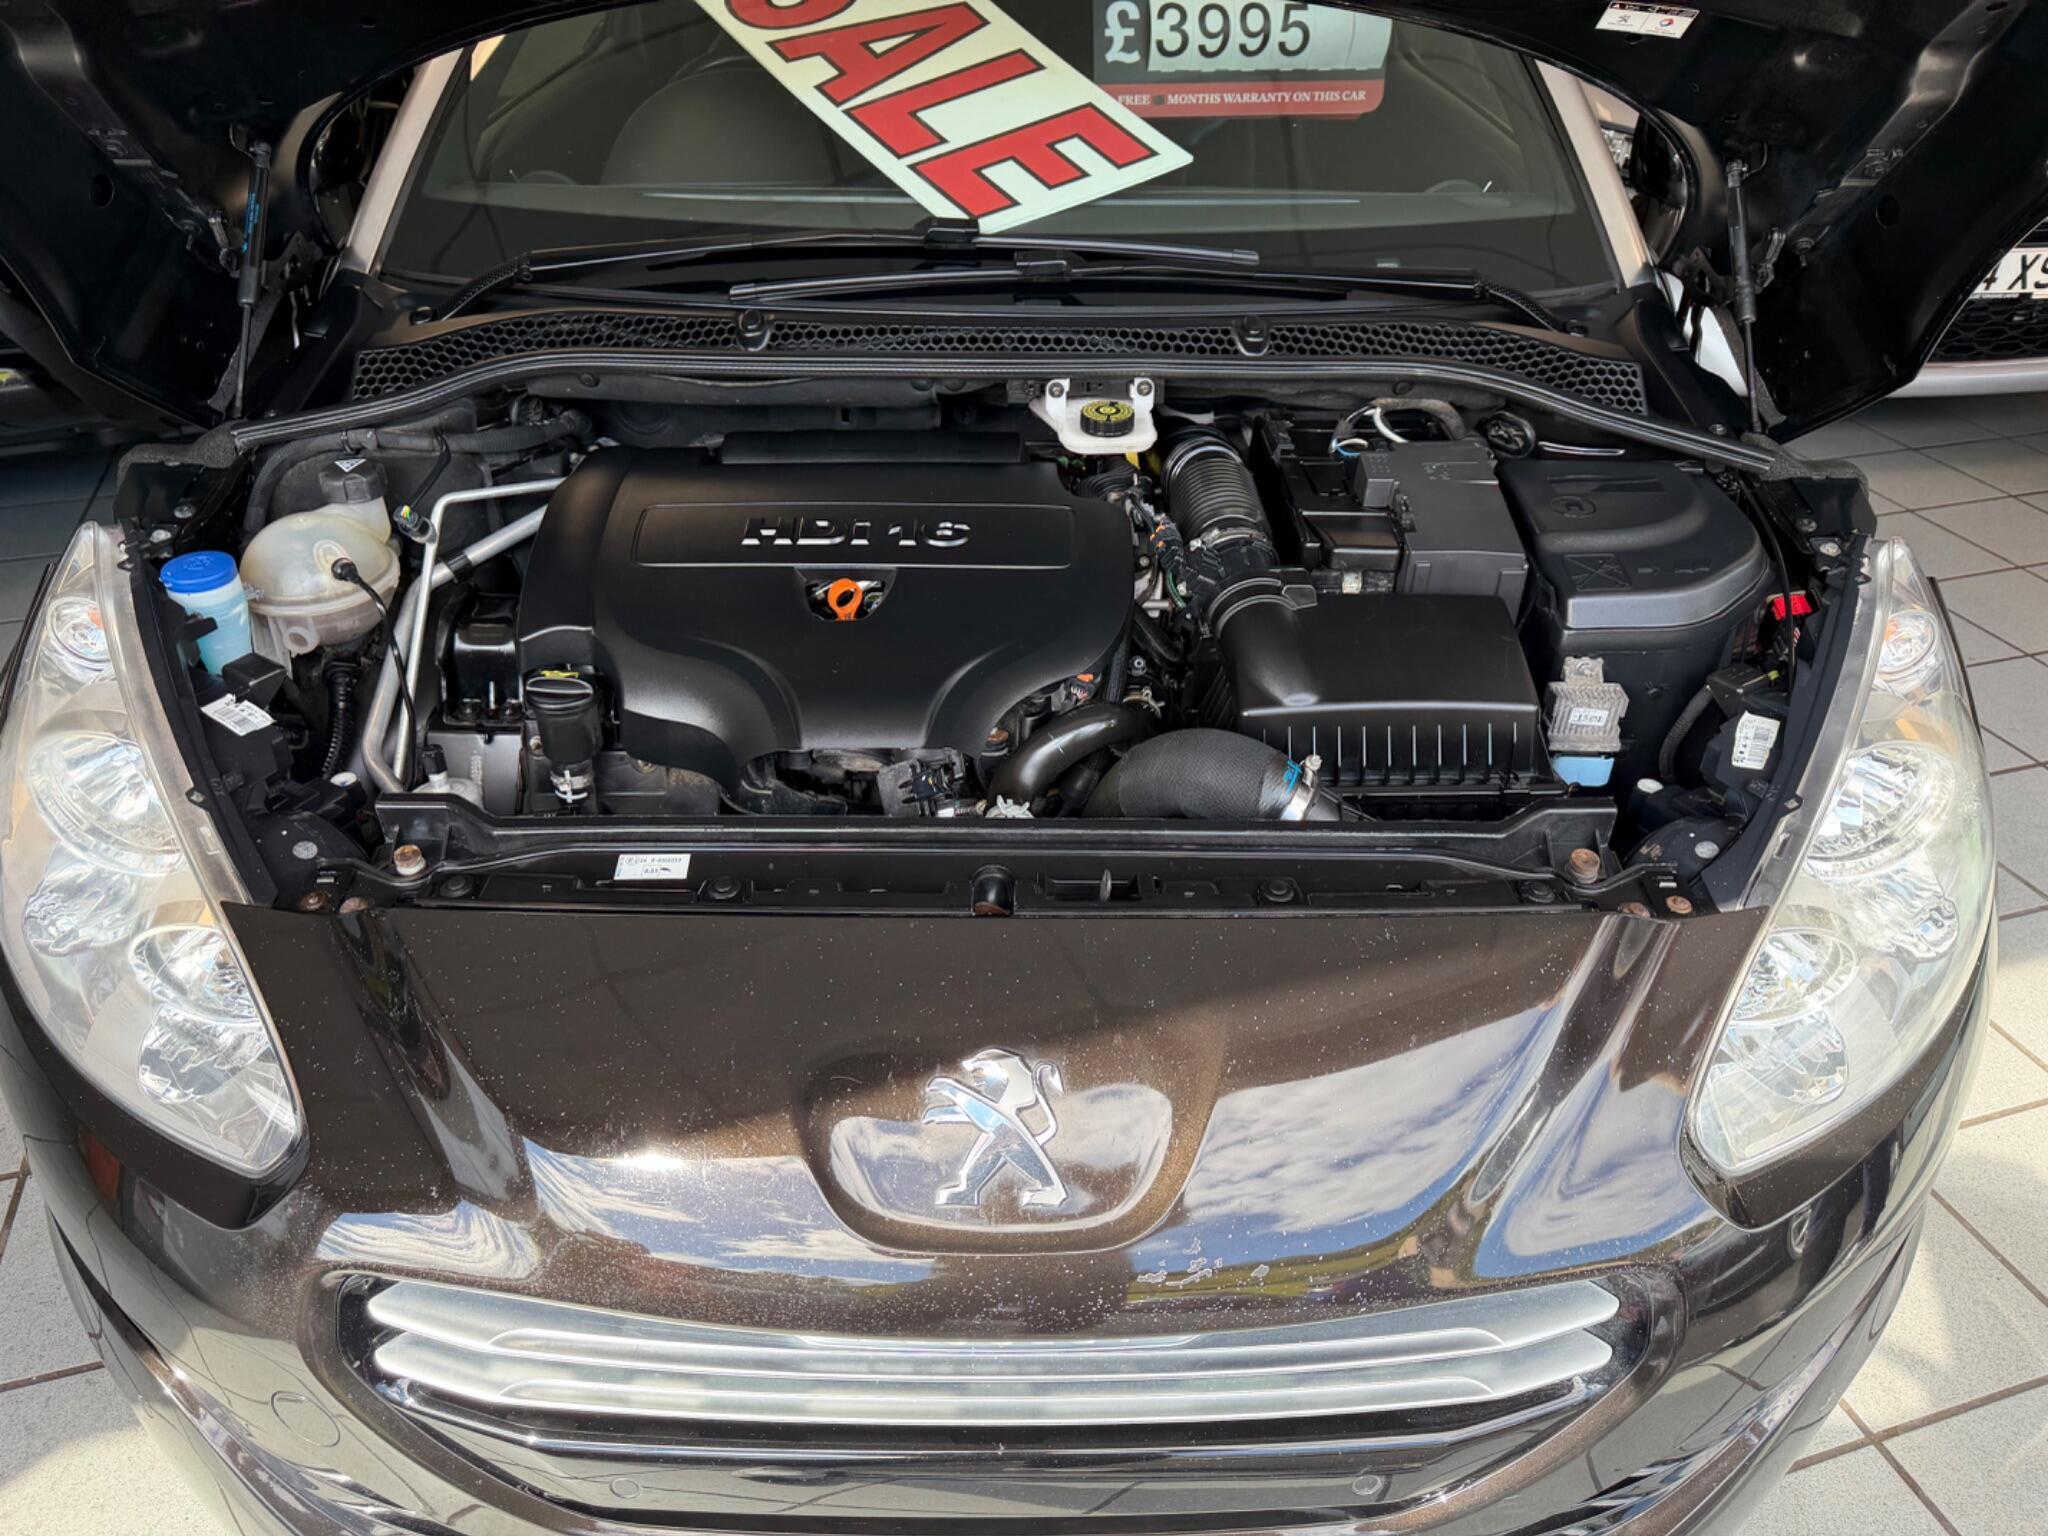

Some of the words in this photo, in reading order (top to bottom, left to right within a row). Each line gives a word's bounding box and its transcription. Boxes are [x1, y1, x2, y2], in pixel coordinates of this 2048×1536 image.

[1117, 94, 1151, 105] FREE
[1167, 92, 1222, 105] MONTHS
[1222, 92, 1292, 104] WARRANTY
[1292, 91, 1311, 103] ON
[1312, 90, 1341, 102] THIS
[1341, 90, 1366, 102] CAR
